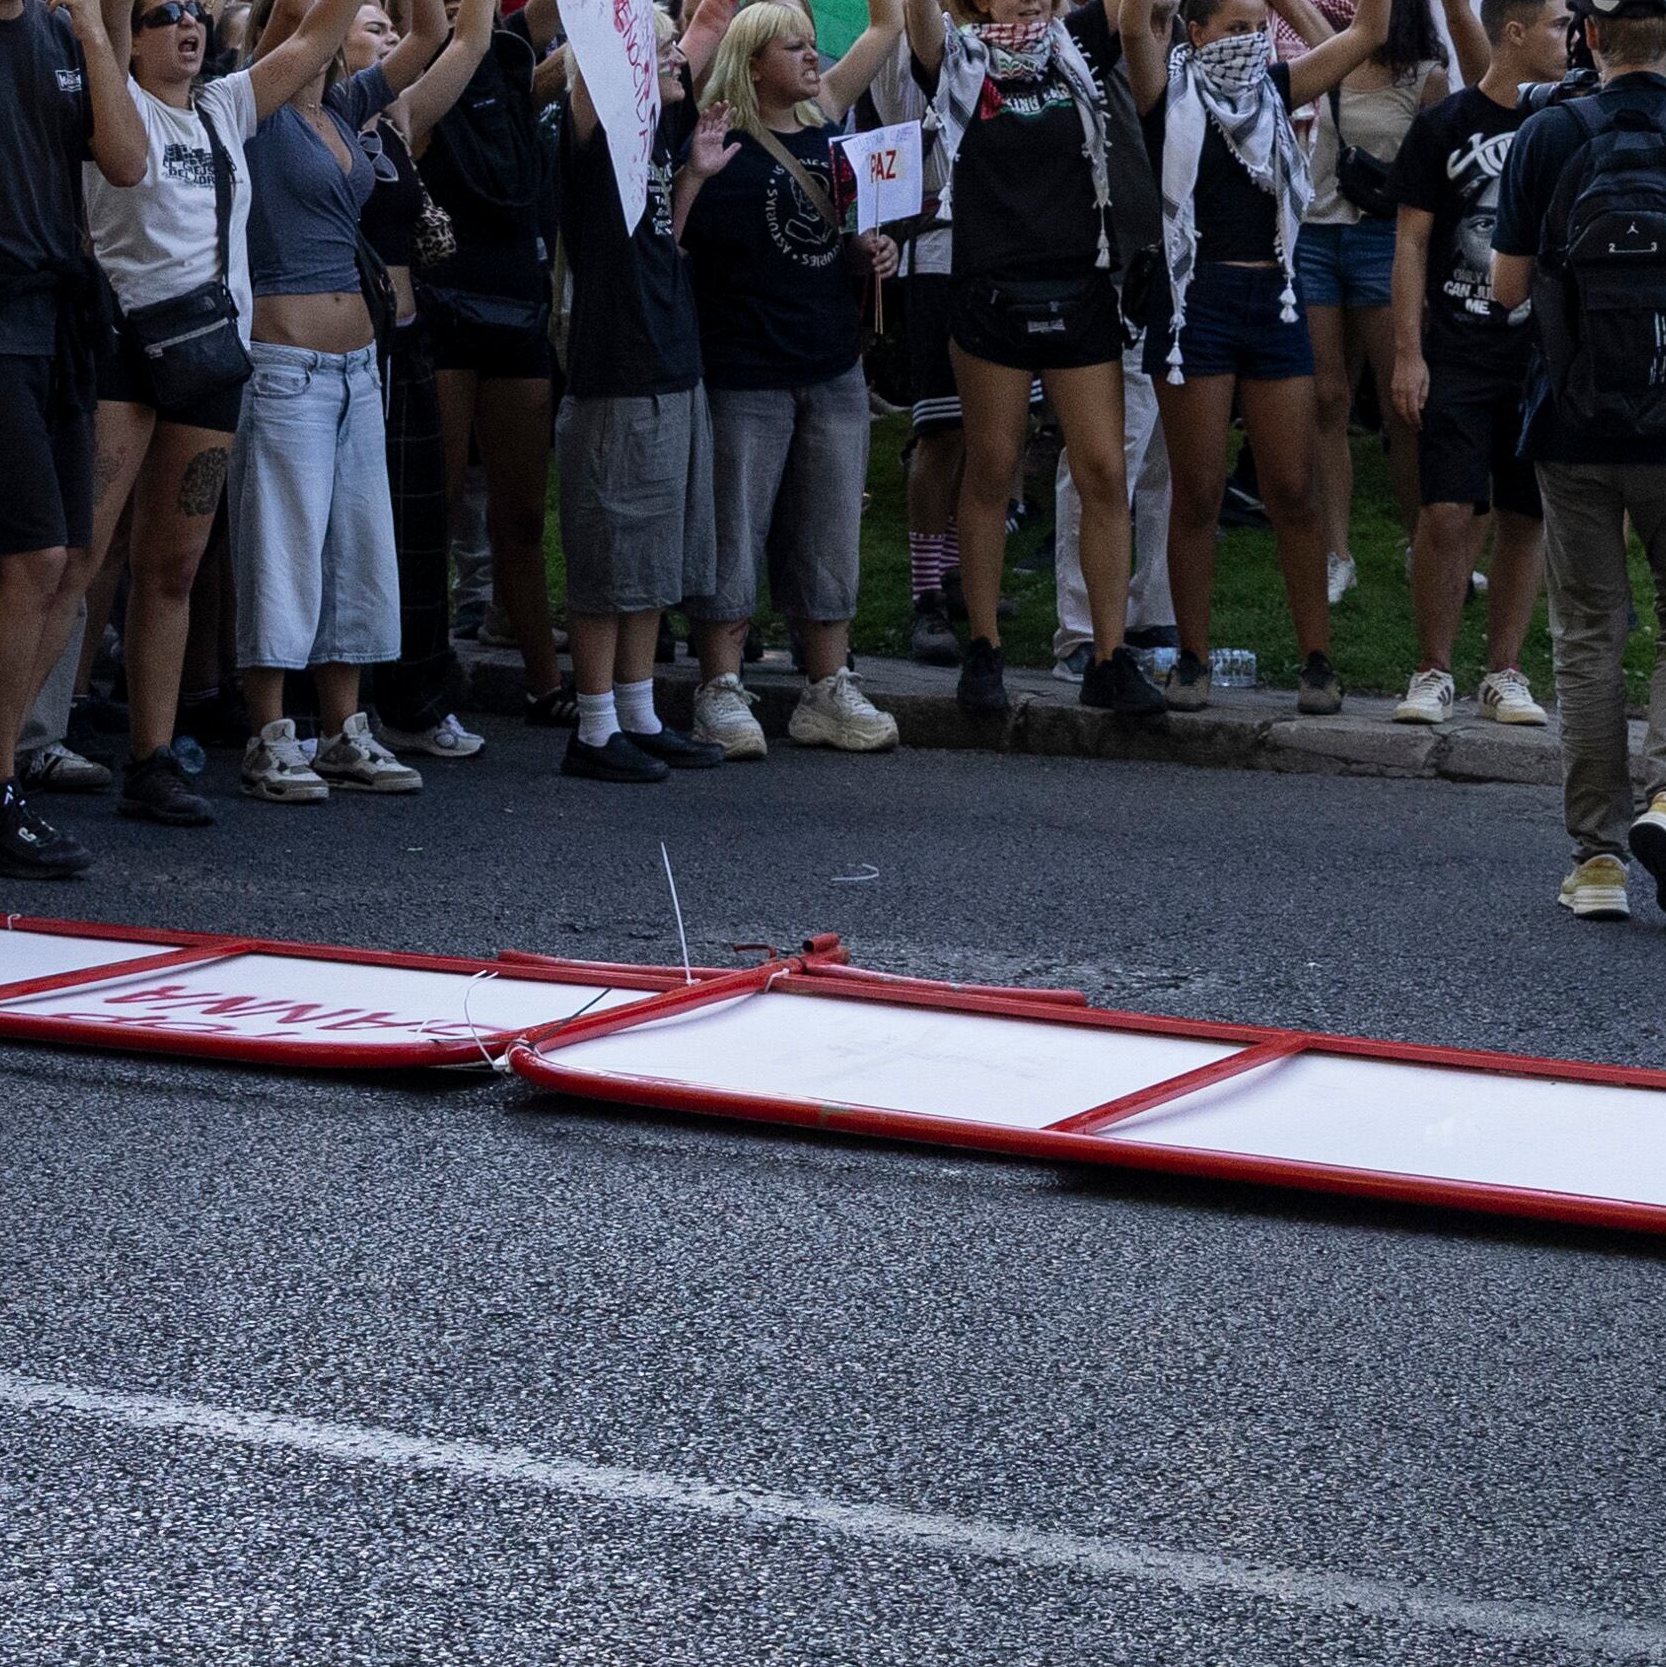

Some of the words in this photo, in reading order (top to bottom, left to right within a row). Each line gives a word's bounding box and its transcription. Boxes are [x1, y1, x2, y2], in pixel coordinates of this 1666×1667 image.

[870, 149, 897, 184] PAZ
[1442, 279, 1472, 298] CAN
[1464, 297, 1491, 315] ME
